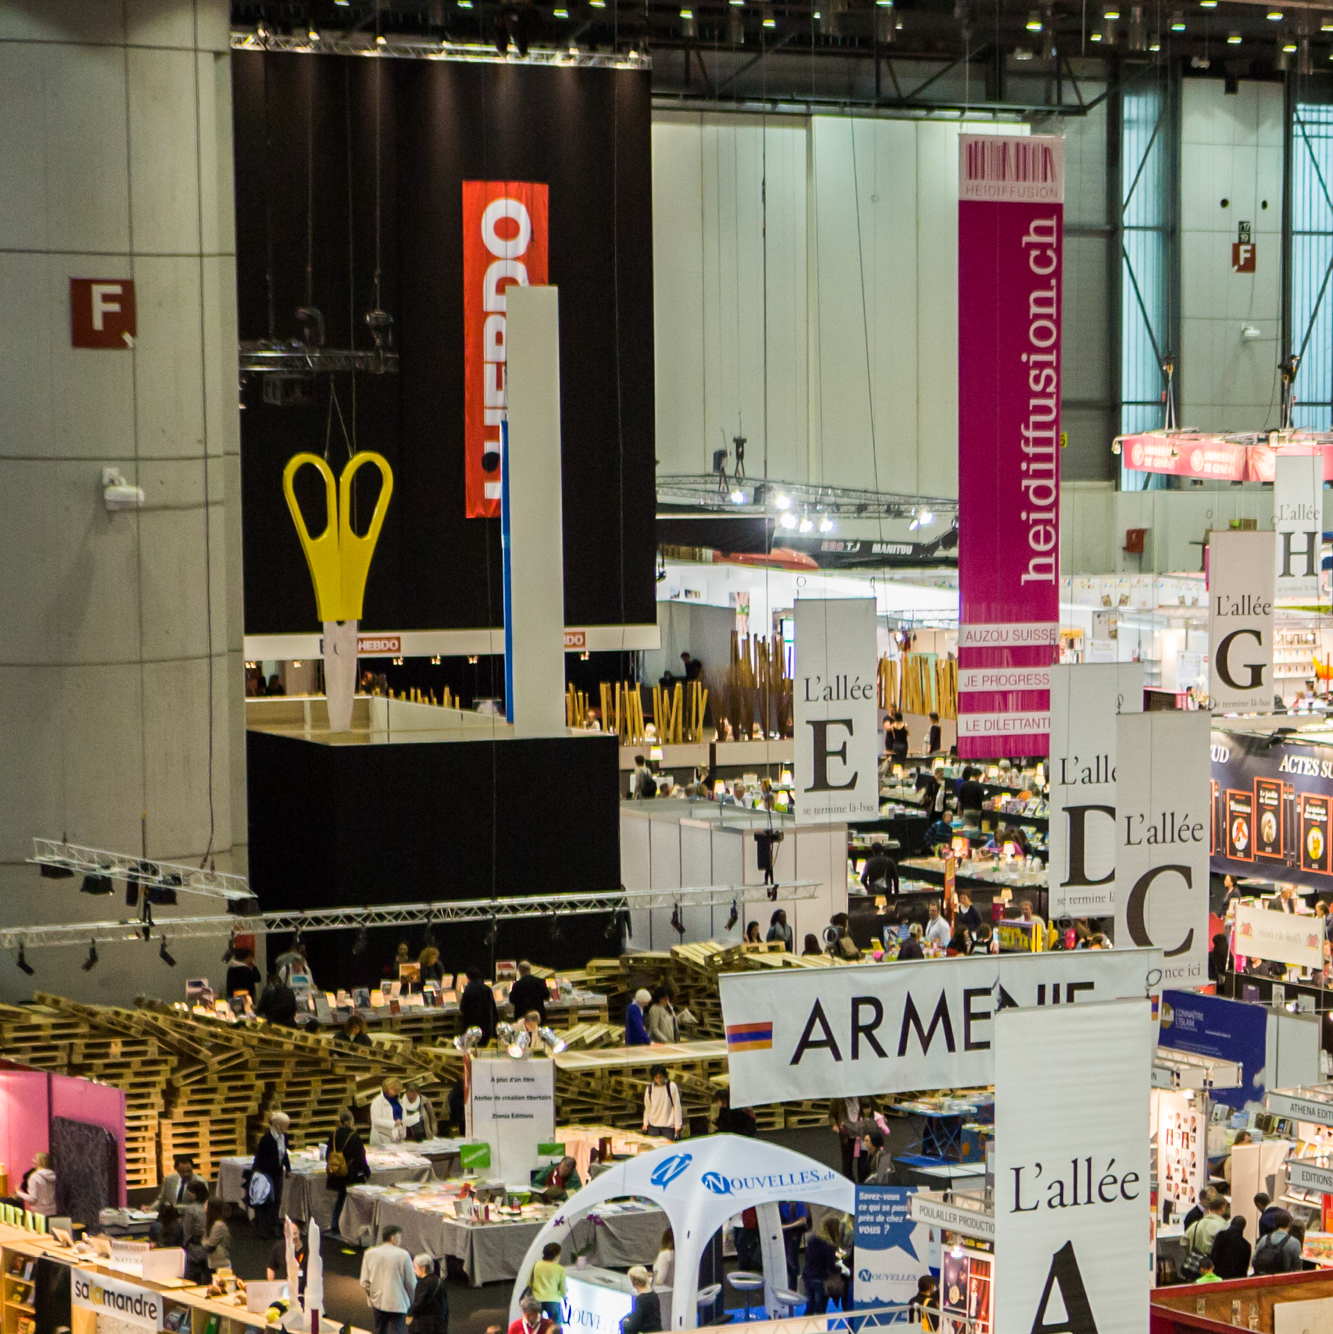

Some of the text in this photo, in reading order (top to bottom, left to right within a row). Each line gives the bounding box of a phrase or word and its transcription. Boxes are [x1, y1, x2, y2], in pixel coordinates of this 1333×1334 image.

[1239, 245, 1252, 266] F
[91, 284, 123, 331] F
[1020, 214, 1058, 586] heidiffusion.ch
[1278, 531, 1318, 578] H
[1216, 595, 1272, 616] L'allée
[965, 628, 1057, 643] AUZOU SUISSE
[1216, 629, 1267, 691] G
[803, 677, 874, 702] L'allée
[804, 718, 859, 793] E
[1279, 754, 1320, 777] ACTES
[1124, 814, 1205, 847] L'allée
[1126, 864, 1194, 956] C
[1290, 1103, 1315, 1118] ATHENA
[1010, 1157, 1140, 1214] L'allée
[1301, 1171, 1333, 1187] EDITIONS
[858, 1192, 900, 1202] Savez-vous
[858, 1213, 903, 1225] près de chez
[75, 1278, 158, 1321] salamandre
